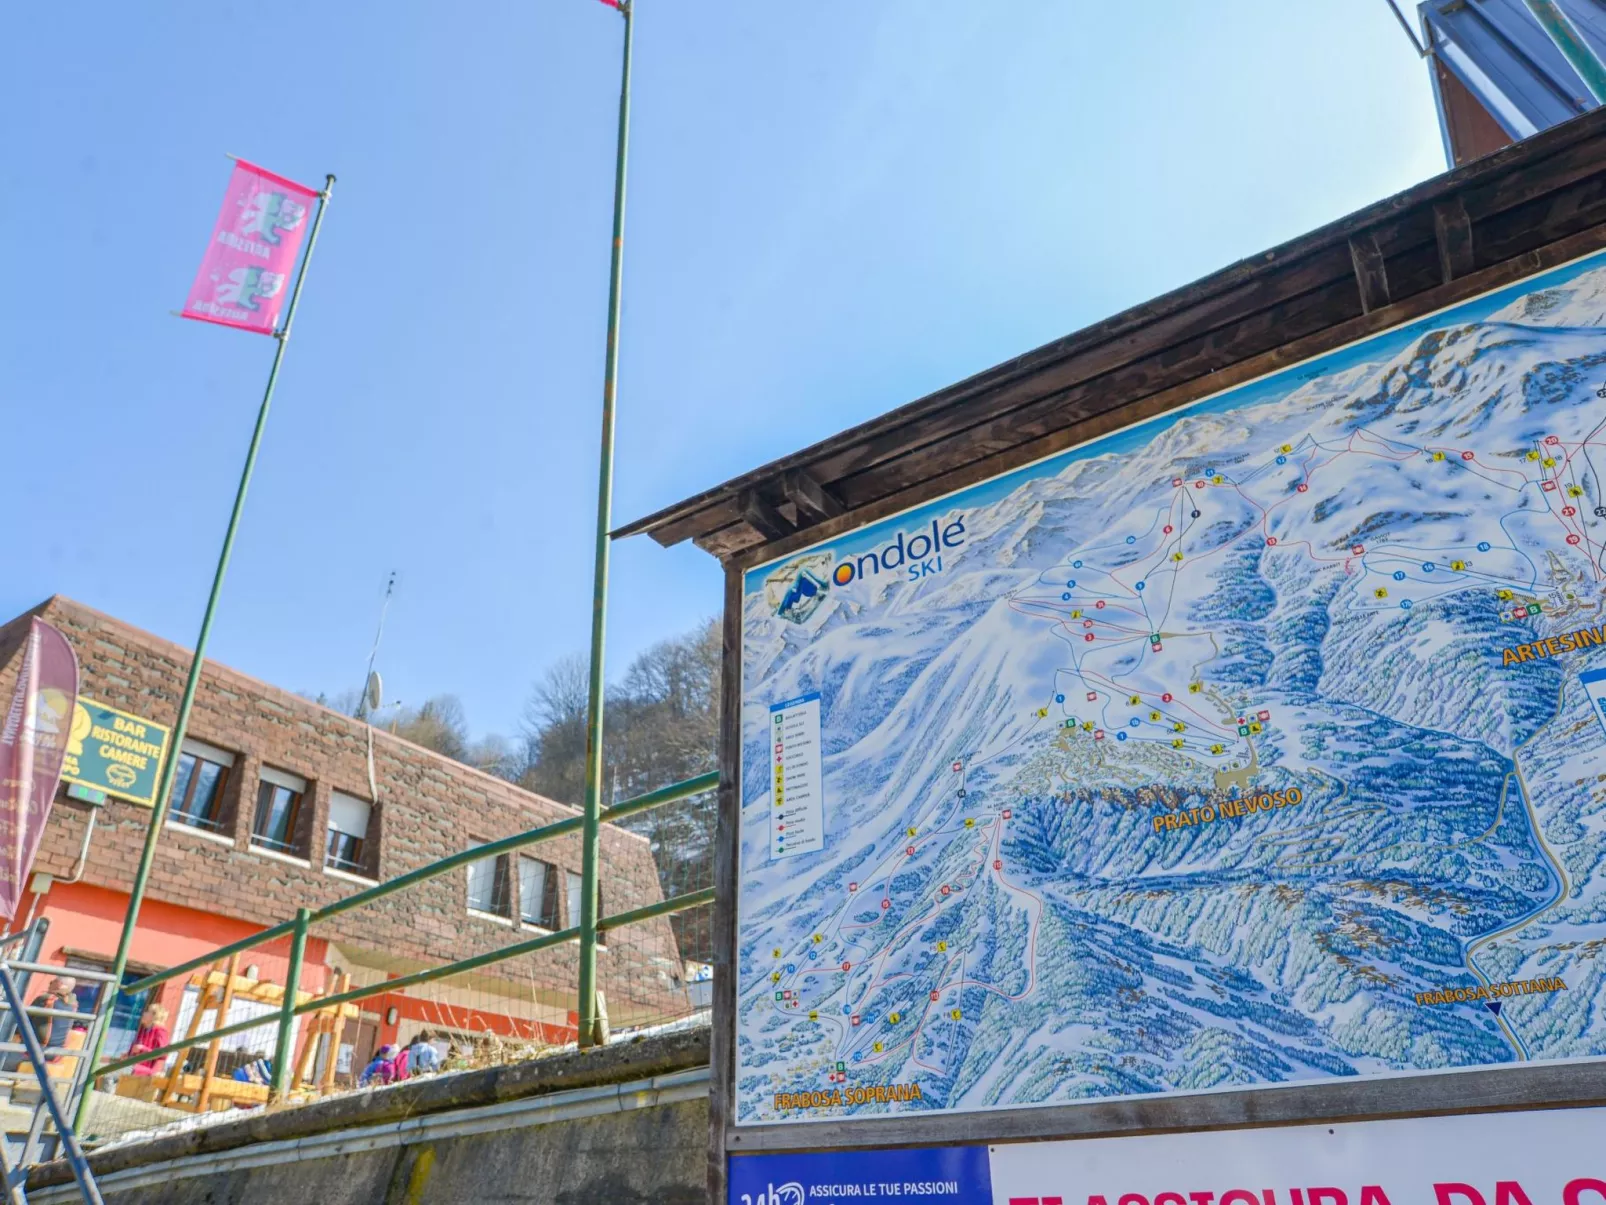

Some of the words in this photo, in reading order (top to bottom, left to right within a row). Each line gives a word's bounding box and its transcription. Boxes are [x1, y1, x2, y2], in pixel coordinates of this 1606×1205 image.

[908, 557, 942, 583] SKI
[91, 724, 161, 759] RISTORANTE
[113, 717, 146, 739] BAR
[99, 744, 148, 771] CAMERE
[1153, 805, 1215, 833] PRATO
[1218, 787, 1303, 820] NEVOSO
[1415, 987, 1488, 1007] FRABOSA
[1488, 977, 1568, 998] SOTTANA
[774, 1088, 843, 1110] FRABOSA
[844, 1082, 922, 1105] SOPRANA
[809, 1183, 862, 1198] ASSICURA
[863, 1183, 876, 1196] LE
[878, 1183, 901, 1196] TUE
[904, 1181, 958, 1195] PASSIONI
